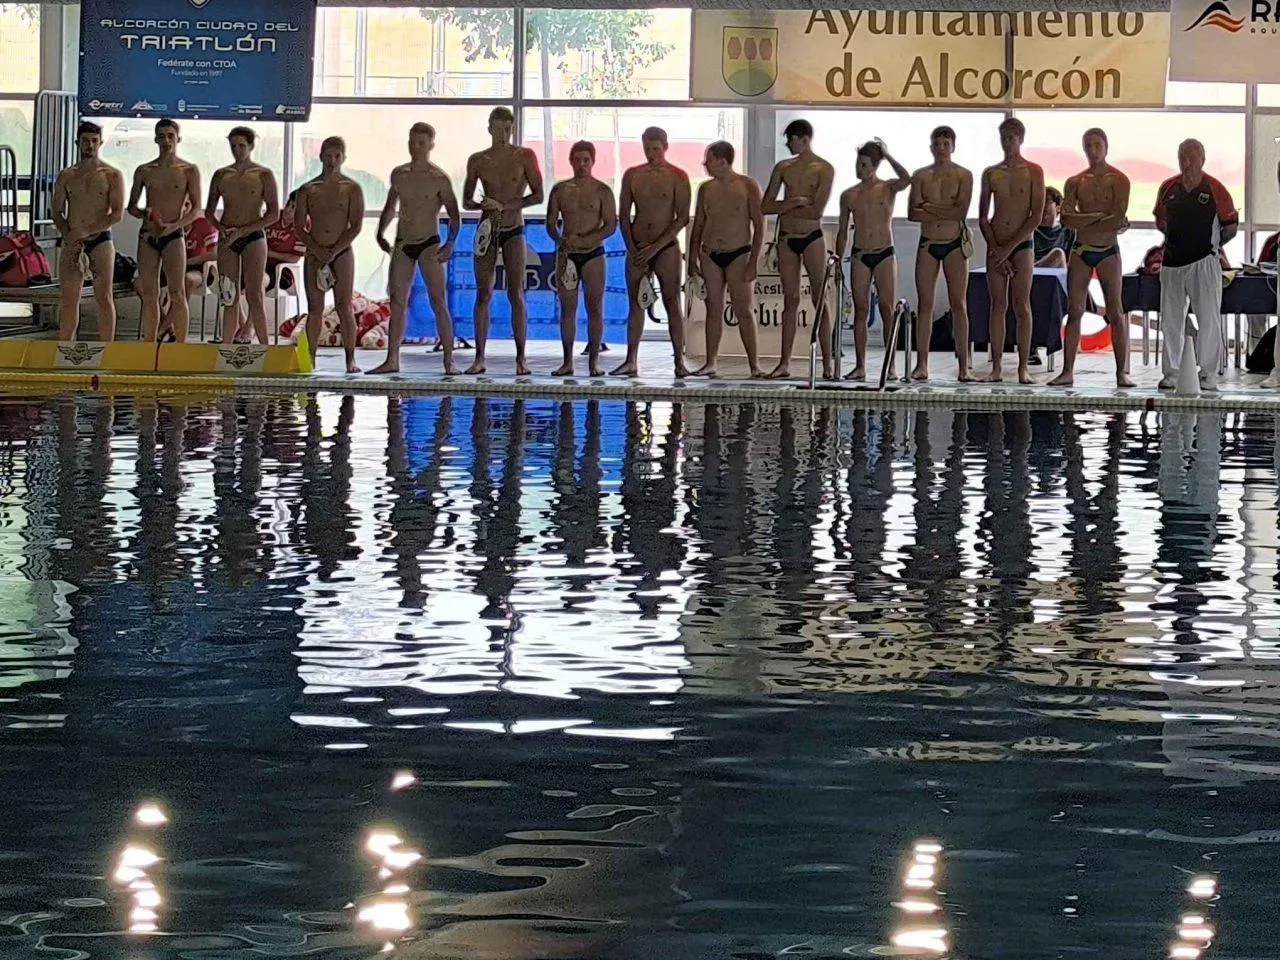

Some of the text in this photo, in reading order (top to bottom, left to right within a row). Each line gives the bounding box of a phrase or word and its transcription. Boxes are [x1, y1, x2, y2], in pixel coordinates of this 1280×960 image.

[100, 18, 299, 32] ALCORCÓN CIUDAD DEL
[805, 9, 1145, 50] Ayuntamiento
[119, 33, 276, 53] TRIATLÓN
[157, 58, 194, 68] Fedérate
[825, 52, 1121, 100] de Alcorcón
